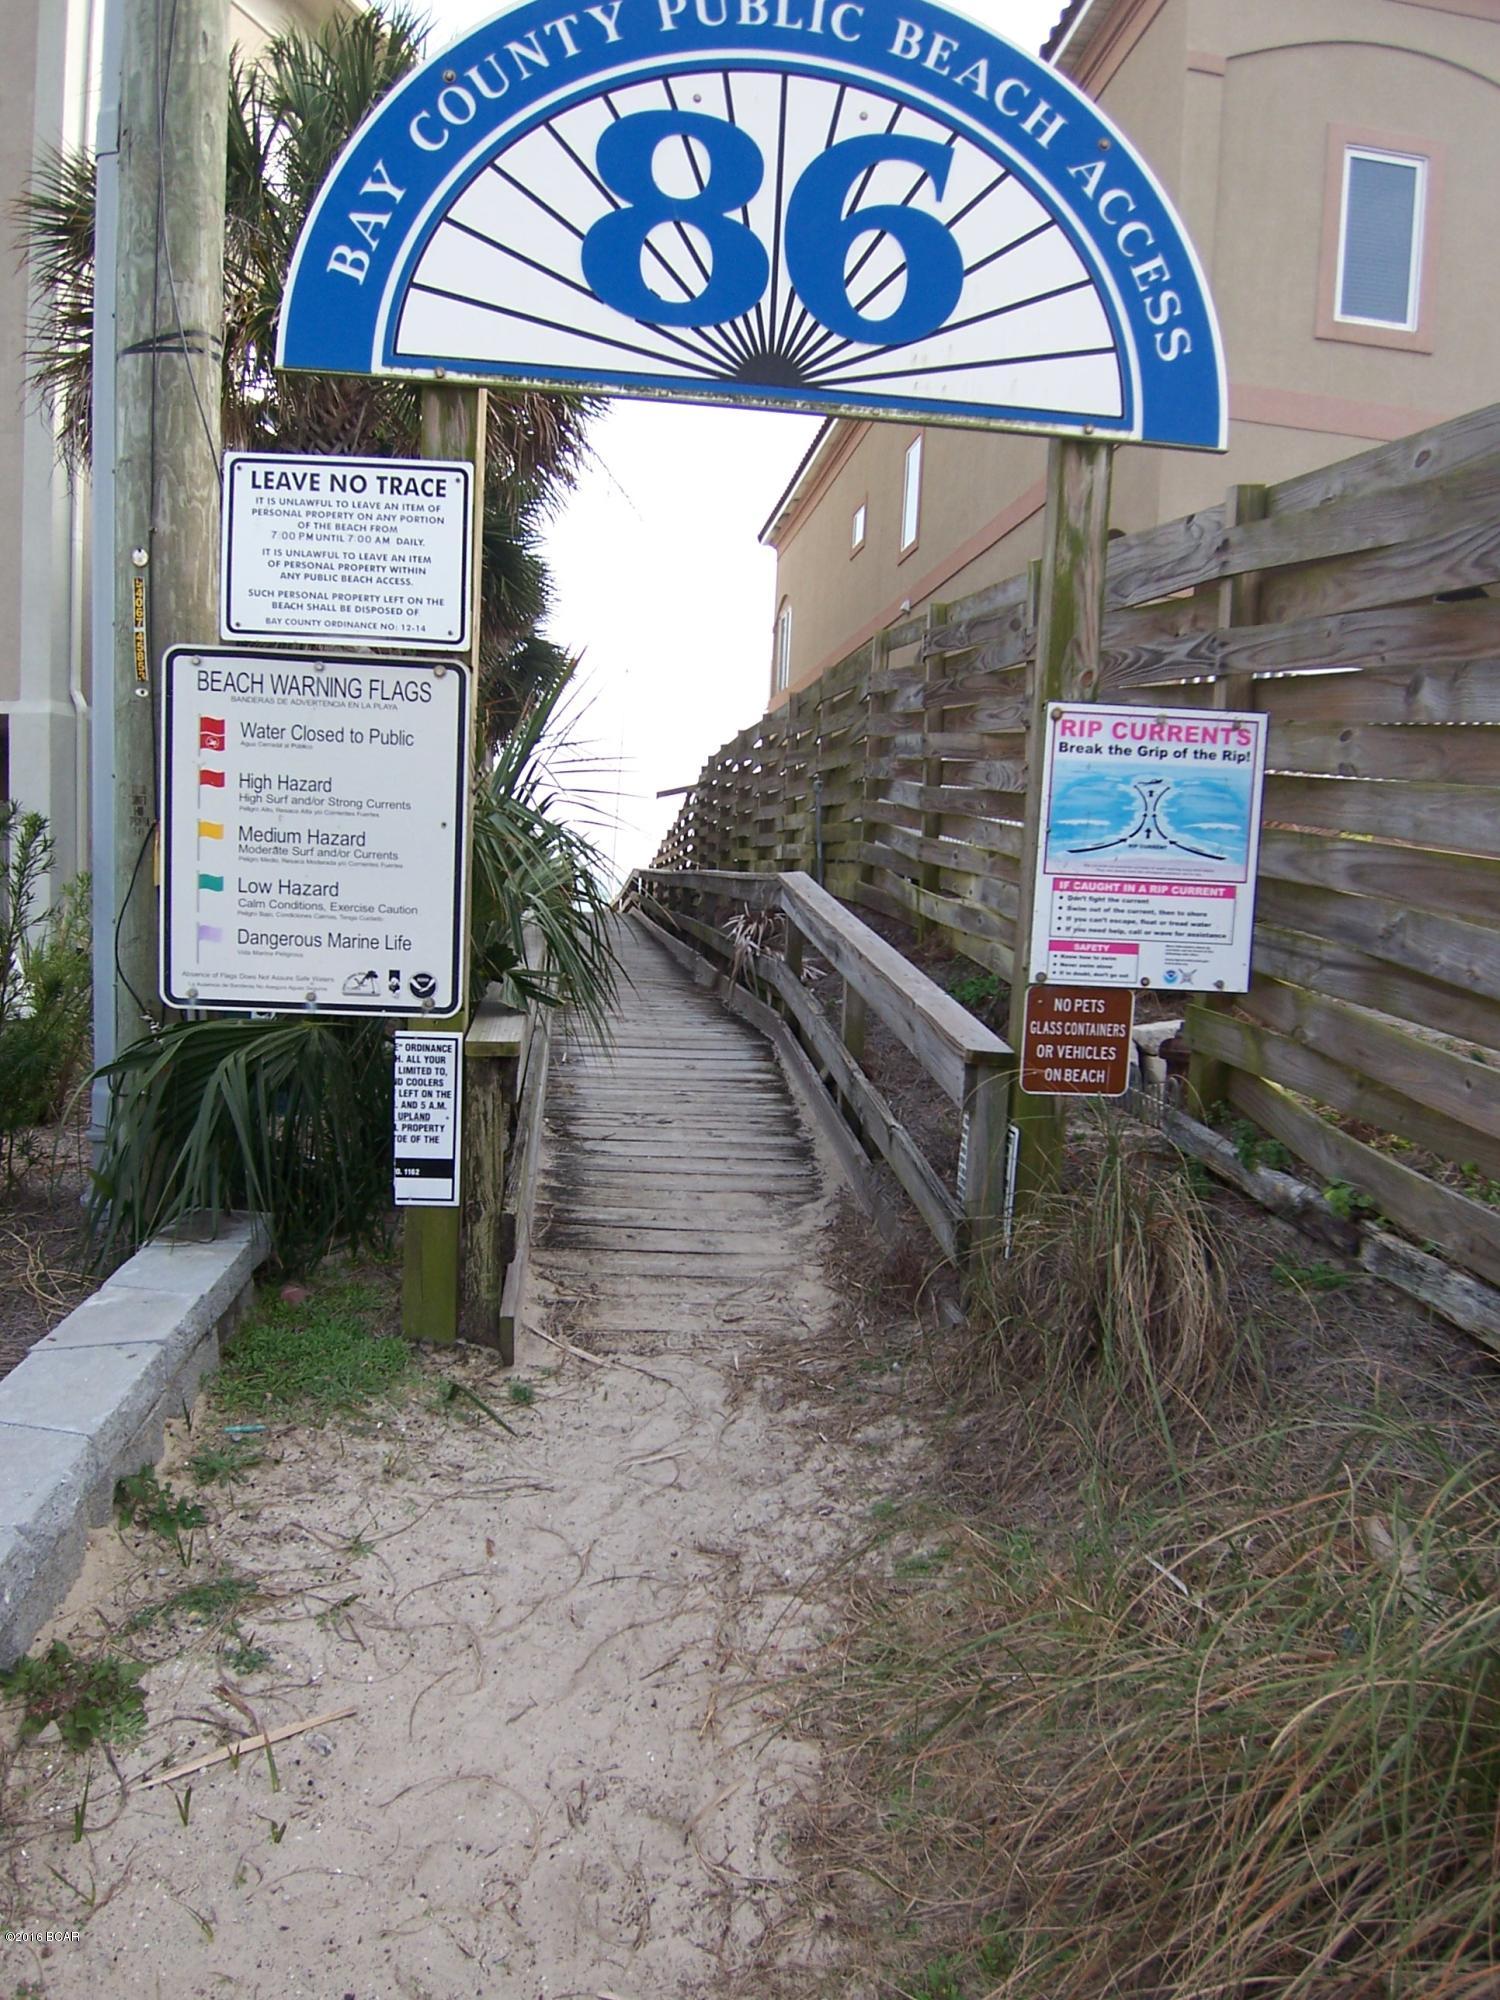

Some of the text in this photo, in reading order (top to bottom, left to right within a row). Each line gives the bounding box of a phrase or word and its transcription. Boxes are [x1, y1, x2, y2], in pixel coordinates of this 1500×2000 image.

[327, 0, 1192, 363] BAY COUNTY PUBLIC BEACH ACCESS
[581, 109, 966, 345] 86
[251, 470, 447, 498] LEAVE NO TRACE
[267, 497, 276, 505] IS
[279, 498, 333, 507] UNLAWFUL
[336, 500, 349, 508] TO
[352, 501, 381, 510] LEAVE
[384, 502, 399, 510] AN
[402, 503, 425, 512] ITEM
[428, 504, 440, 512] OF
[252, 508, 444, 524] PERSONAL PROPERTY ON ANY PORTION
[297, 521, 398, 533] OF THE BEACH FROM
[299, 532, 314, 541] PM
[316, 533, 344, 542] UNTIL
[375, 536, 390, 544] AM
[274, 548, 282, 557] IS
[286, 549, 340, 559] UNLAWFUL
[343, 552, 356, 560] TO
[359, 552, 388, 562] LEAVE
[391, 554, 406, 562] AN
[409, 555, 431, 564] ITEM
[267, 560, 426, 575] OF PERSONAL PROPERTY WITHIN
[280, 572, 301, 580] ANY
[304, 573, 338, 582] PUBLIC
[341, 575, 373, 584] BEACH
[248, 588, 444, 606] SUCH PERSONAL PROPERTY LEFT ON THE
[272, 601, 303, 610] BEACH
[307, 603, 337, 612] SHALL
[340, 604, 351, 613] BE
[354, 605, 403, 615] DISPOSED
[285, 618, 322, 627] COUNTY
[324, 620, 377, 630] ORDINANCE
[401, 624, 426, 632] 12-14
[197, 670, 432, 703] BEACH WARNING FLAGS
[230, 695, 275, 704] BANDERAS
[277, 697, 288, 705] DE
[290, 698, 346, 708] ADVERTENCIA
[373, 702, 398, 711] PLAYA
[240, 722, 414, 746] Water Closed to Public
[1061, 720, 1251, 746] RIP CURRENTS
[1059, 742, 1250, 763] Break the Grip of the Rip!
[239, 772, 332, 793] High Hazard
[239, 792, 411, 810] High Surf and/or Strong Currents
[239, 825, 366, 847] Medium Hazard
[238, 844, 399, 861] Moderate Surf and/or Currents
[238, 877, 339, 897] Low Hazard
[1059, 882, 1225, 896] IF CAUGHT IN A RIP CURRENT
[238, 898, 418, 915] Calm Conditions, Exercise Caution
[238, 928, 412, 951] Dangerous Marine Life
[1074, 944, 1109, 952] SAFETY
[1054, 998, 1105, 1013] NO PETS
[1030, 1022, 1126, 1037] GLASS CONTAINERS
[405, 1044, 452, 1052] ORDINANCE
[1037, 1044, 1116, 1060] OR VEHICLES
[407, 1056, 446, 1064] ALL YOUR
[398, 1067, 448, 1076] LIMITED TO,
[1044, 1068, 1105, 1083] ON BEACH
[402, 1124, 444, 1132] PROPERTY
